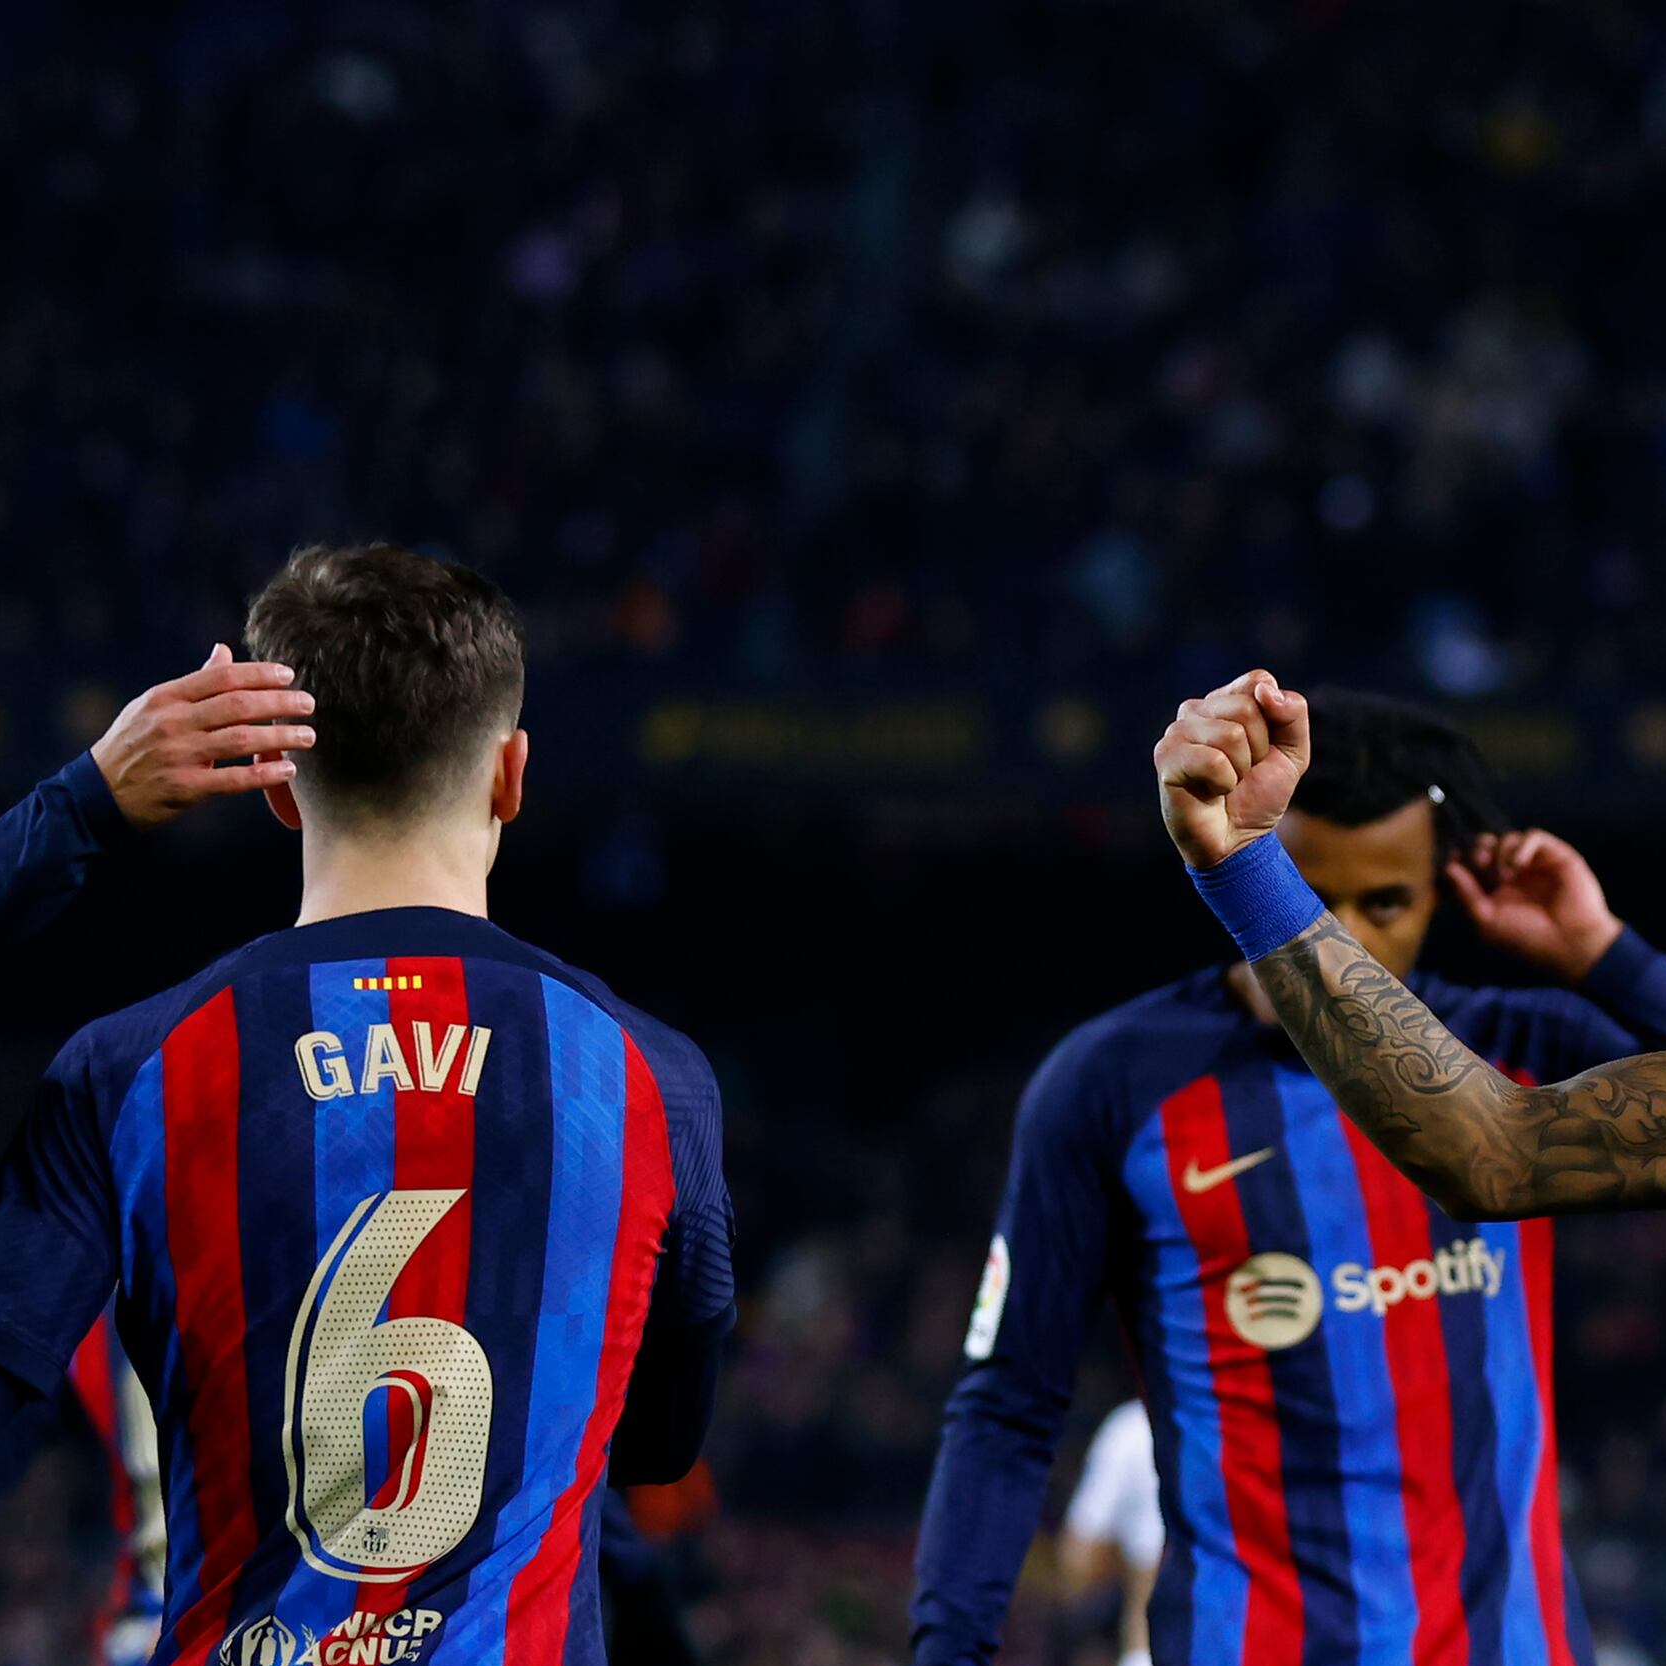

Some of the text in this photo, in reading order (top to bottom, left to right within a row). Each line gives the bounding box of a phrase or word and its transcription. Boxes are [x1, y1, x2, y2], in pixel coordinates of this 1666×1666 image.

[293, 1019, 493, 1101] GAVI
[1332, 1236, 1506, 1319] Spotify
[282, 1188, 494, 1585] 6
